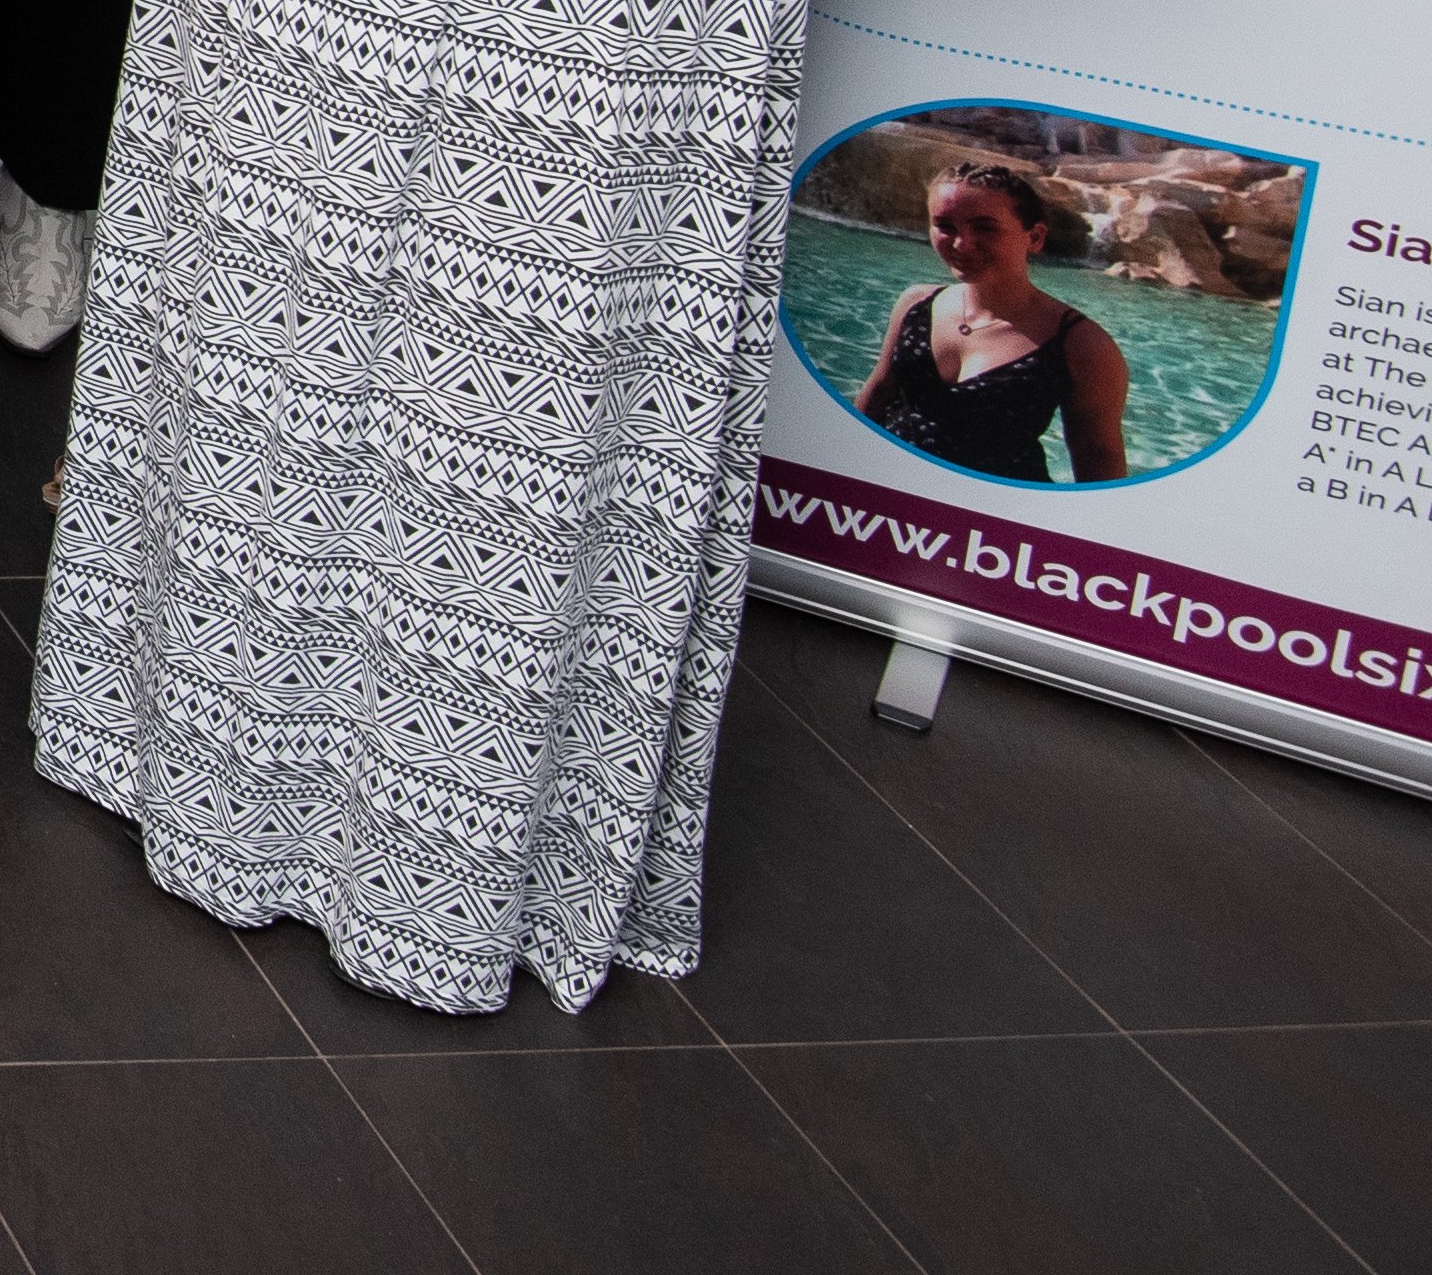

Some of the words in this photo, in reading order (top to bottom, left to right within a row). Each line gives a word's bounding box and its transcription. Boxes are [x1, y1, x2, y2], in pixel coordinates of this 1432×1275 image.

[1335, 285, 1405, 318] Sian
[1322, 352, 1354, 373] at
[1365, 356, 1426, 388] The
[1311, 410, 1401, 447] BTEC
[1407, 434, 1431, 456] A
[1345, 450, 1373, 474] in
[1382, 461, 1406, 482] A
[1416, 467, 1432, 489] L
[1297, 476, 1315, 493] a
[1327, 479, 1348, 500] B
[1358, 486, 1385, 510] in
[1394, 496, 1417, 518] A
